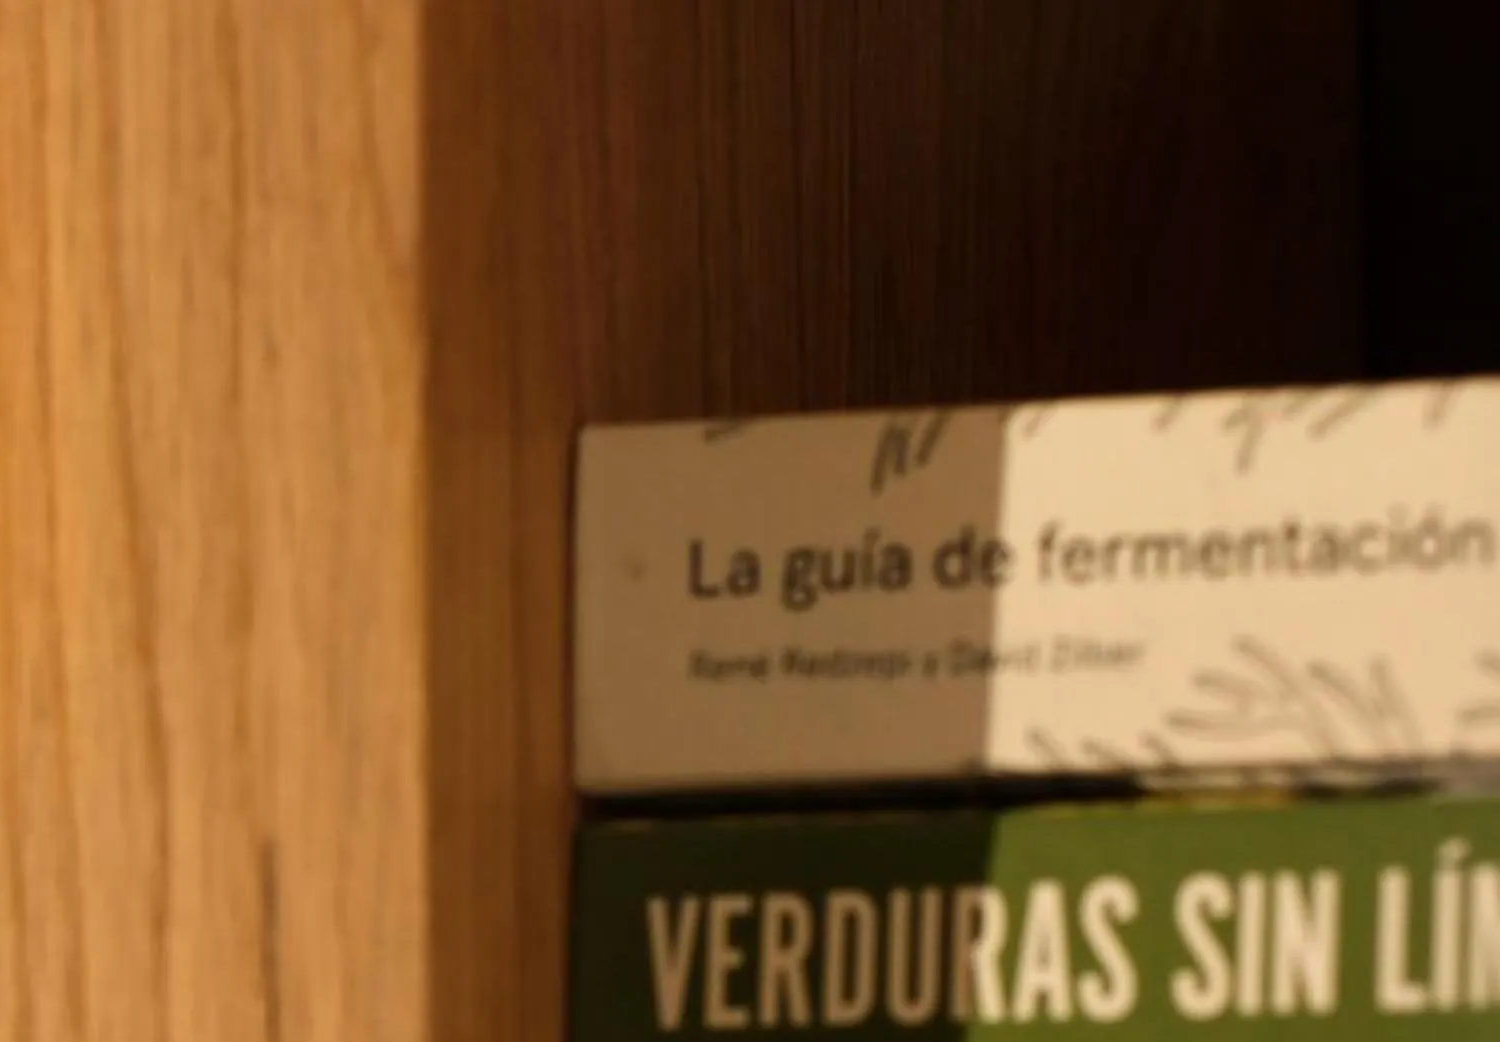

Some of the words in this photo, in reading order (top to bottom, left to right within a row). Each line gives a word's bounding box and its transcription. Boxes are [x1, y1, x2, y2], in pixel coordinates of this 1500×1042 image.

[687, 536, 762, 600] La
[779, 525, 914, 614] guía
[932, 524, 1015, 592] de
[1036, 500, 1497, 588] fermentación
[645, 872, 1142, 1032] VERDURAS
[1170, 867, 1340, 1019] SIN
